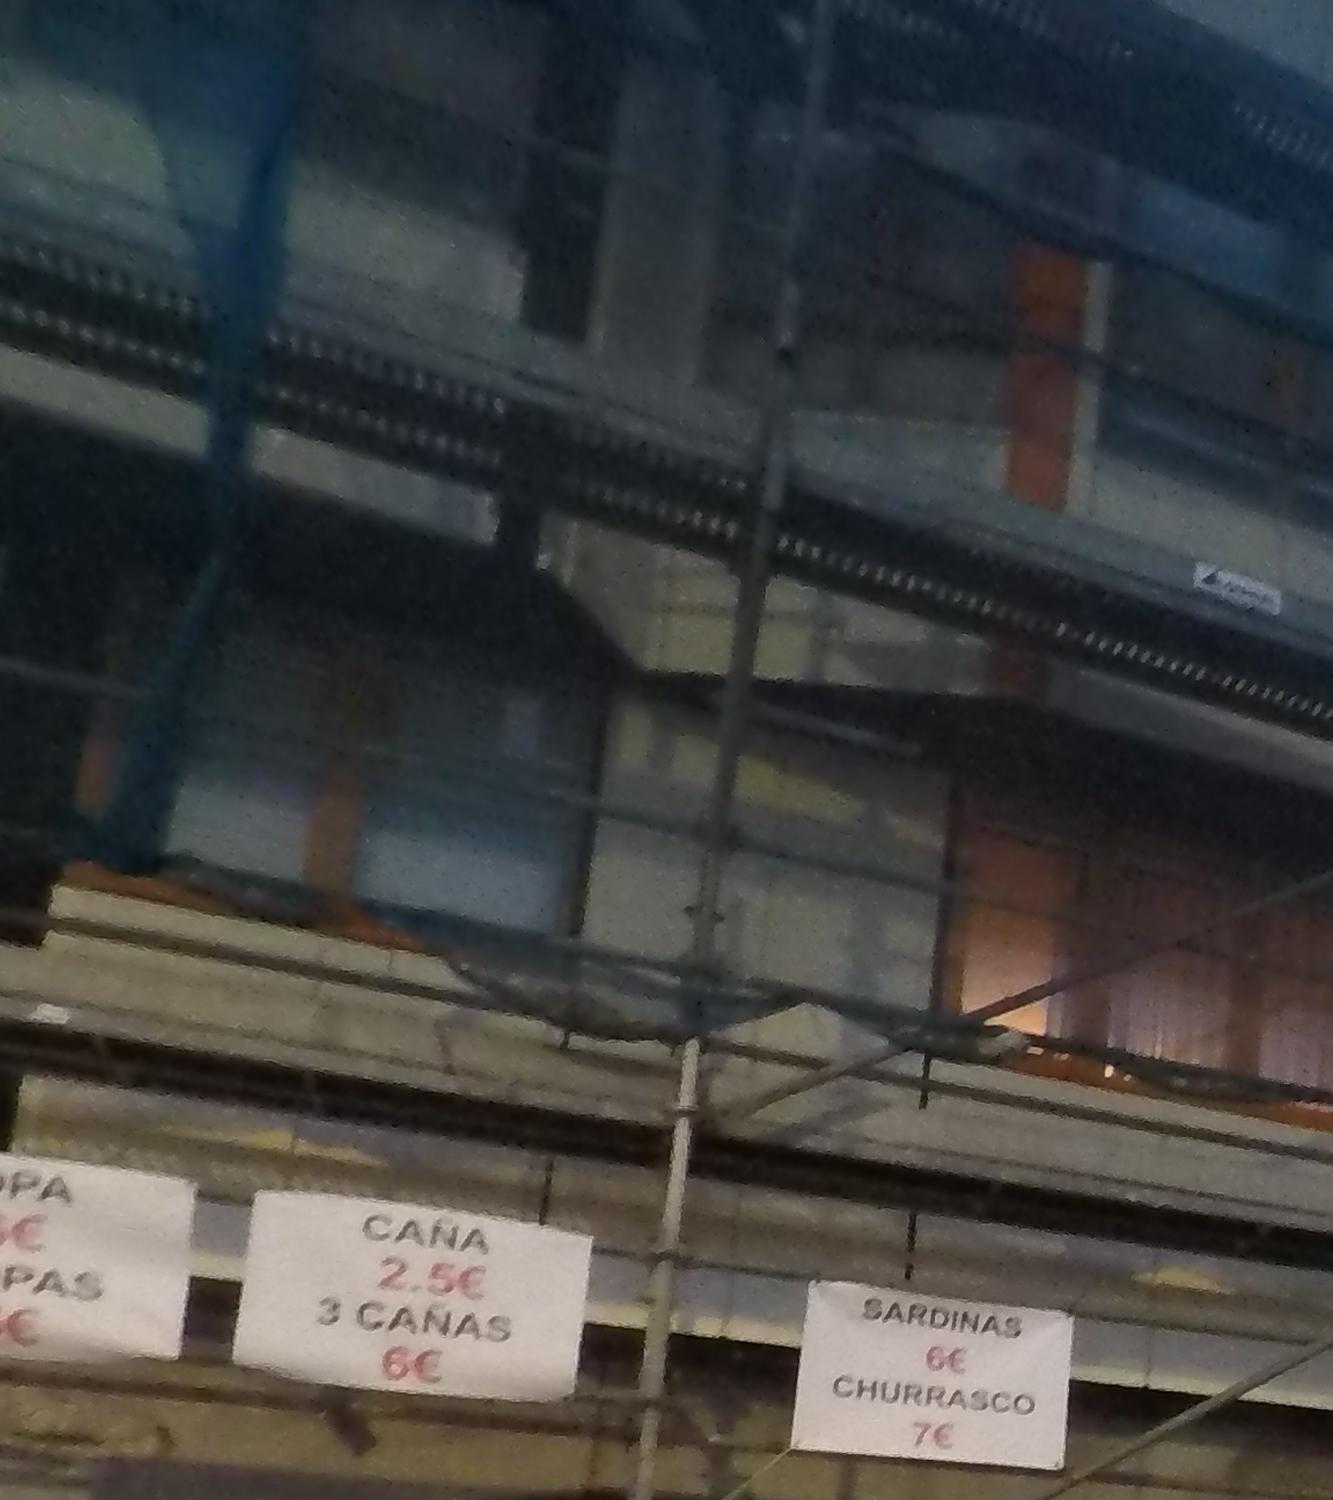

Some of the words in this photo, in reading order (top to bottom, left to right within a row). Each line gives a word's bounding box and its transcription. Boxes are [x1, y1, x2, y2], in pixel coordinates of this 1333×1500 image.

[0, 1169, 72, 1206] PA
[362, 1214, 489, 1254] CAÑA
[1, 1264, 104, 1301] PAS
[377, 1256, 487, 1300] 2.5€
[317, 1297, 341, 1326] 3
[356, 1301, 513, 1342] CAÑAS
[861, 1298, 1023, 1339] SARDINAS
[381, 1346, 443, 1384] 6€
[832, 1374, 1036, 1416] CHURRASCO
[913, 1421, 955, 1450] 7€
